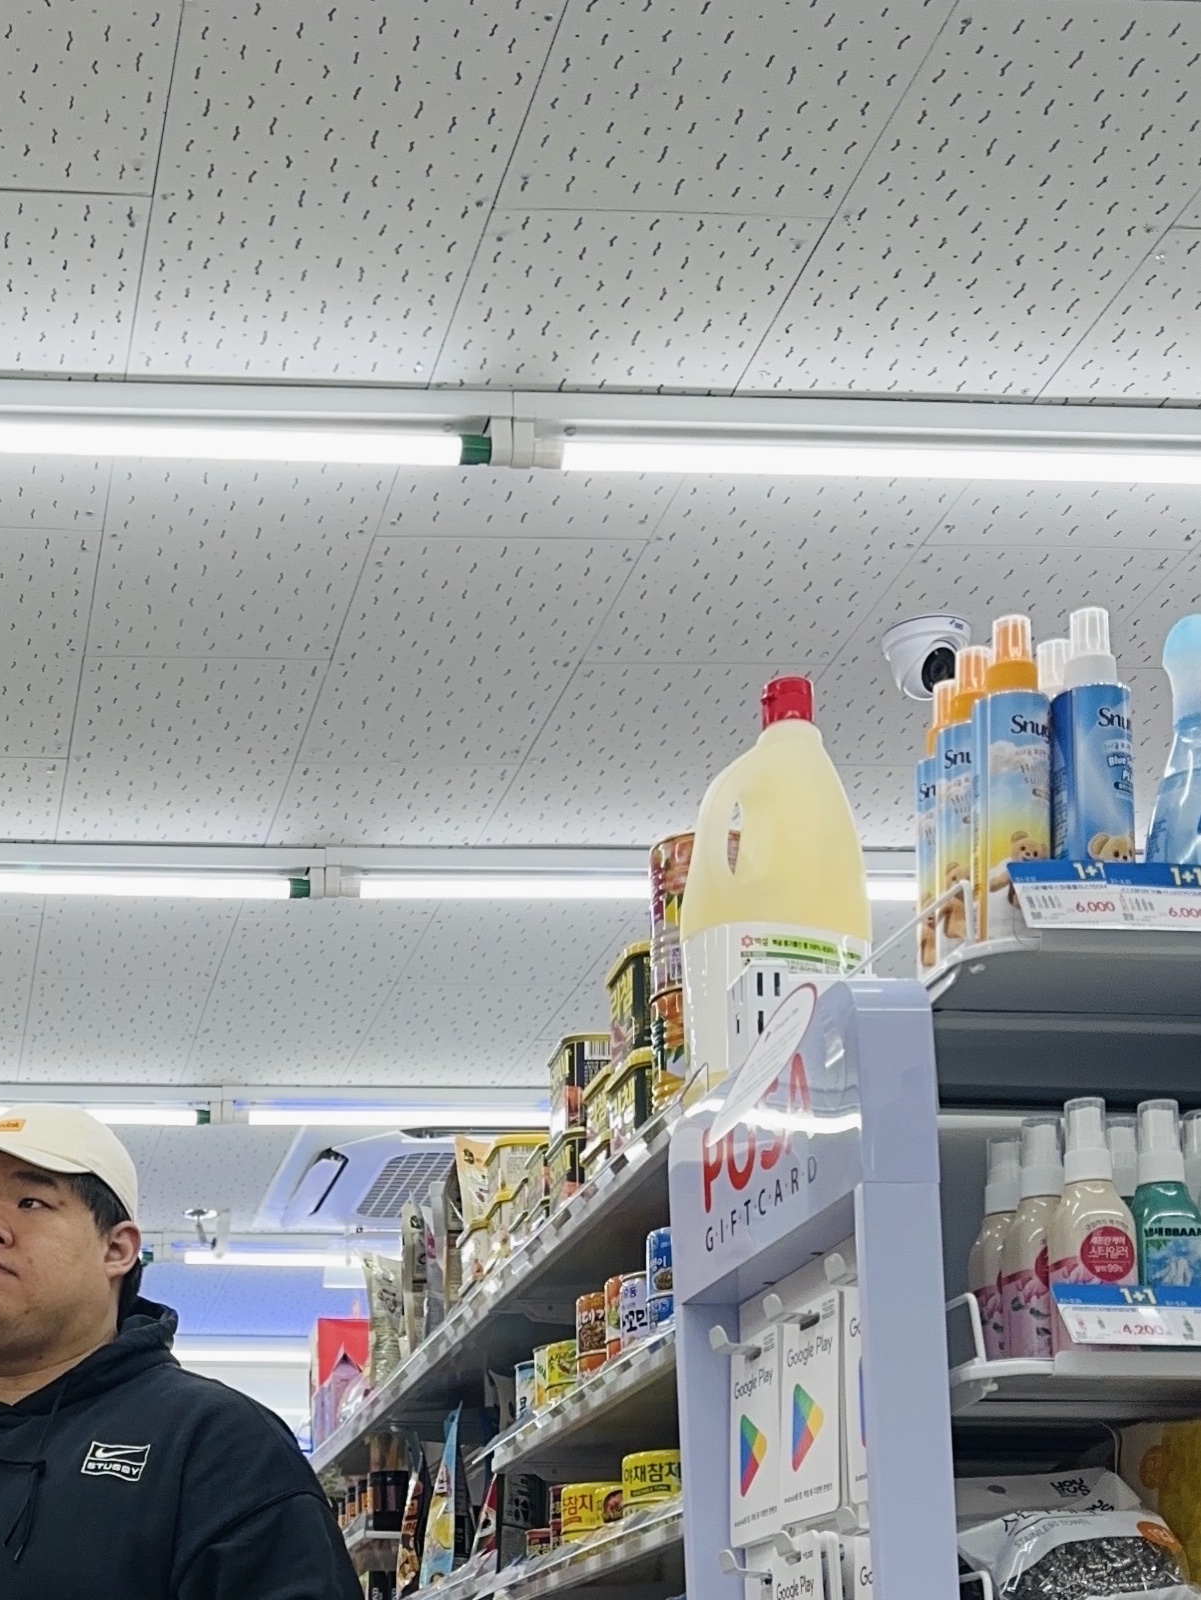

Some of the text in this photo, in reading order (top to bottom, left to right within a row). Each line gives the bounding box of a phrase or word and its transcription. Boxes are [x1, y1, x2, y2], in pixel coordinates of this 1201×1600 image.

[1075, 901, 1116, 914] 6,000
[1168, 907, 1201, 919] 6,00
[1119, 1287, 1157, 1306] 1+1
[849, 1317, 862, 1338] Go
[1121, 1322, 1164, 1336] 4,200
[786, 1334, 834, 1369] Google Play
[734, 1366, 775, 1400] Google Play
[800, 1575, 815, 1597] Play
